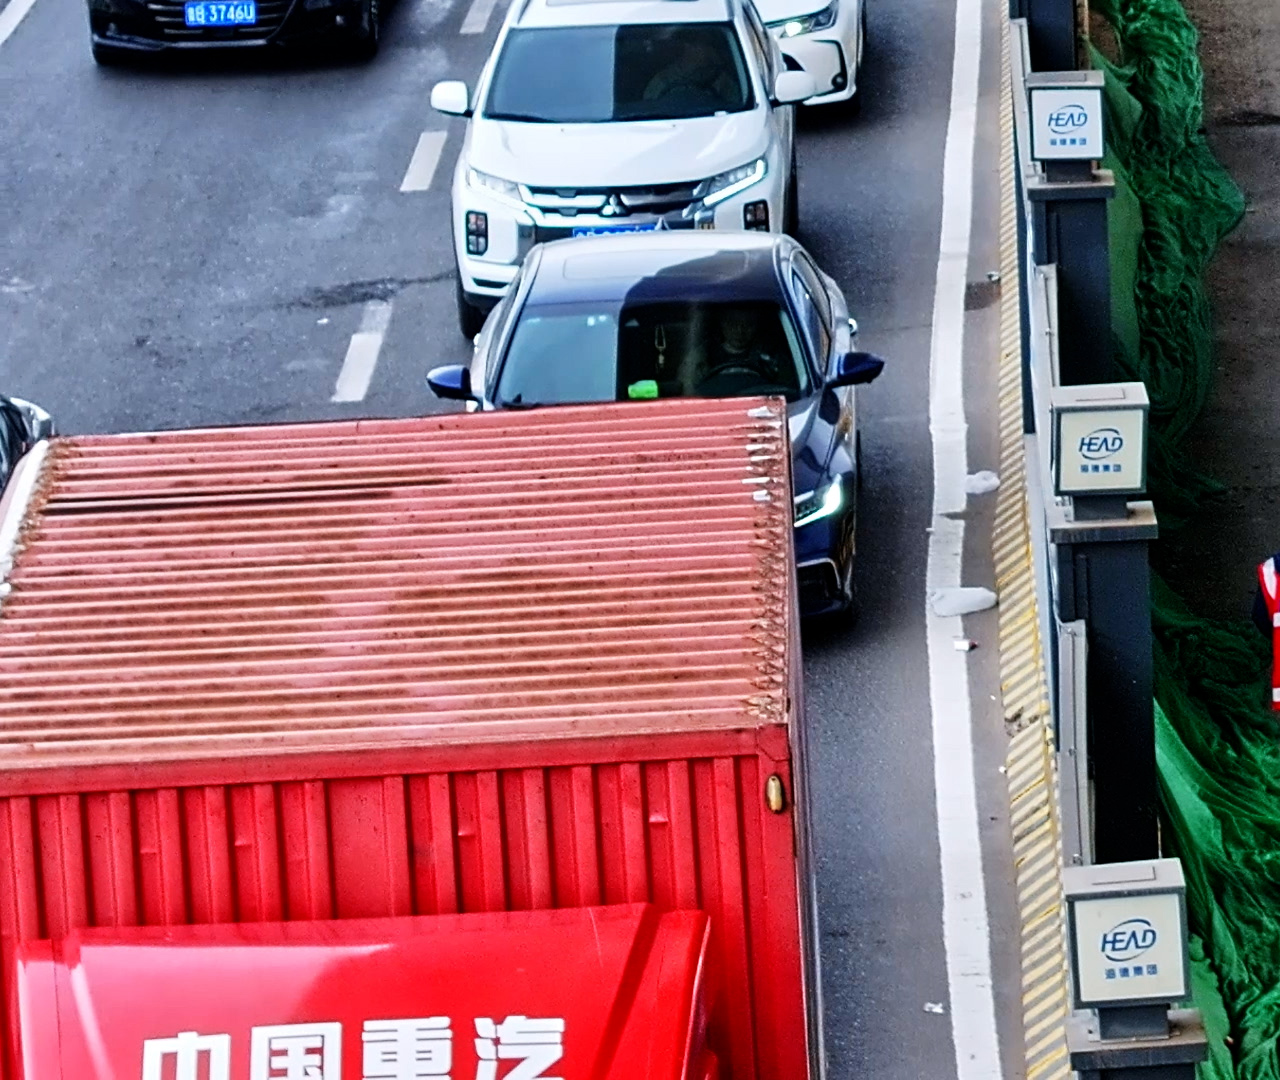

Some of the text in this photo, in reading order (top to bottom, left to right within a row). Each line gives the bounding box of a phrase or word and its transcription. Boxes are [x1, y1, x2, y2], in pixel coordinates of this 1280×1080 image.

[1048, 112, 1088, 127] HEAD
[1079, 437, 1124, 452] HEAD
[1101, 929, 1157, 953] HEAD
[142, 1015, 565, 1080] 中国重汽
